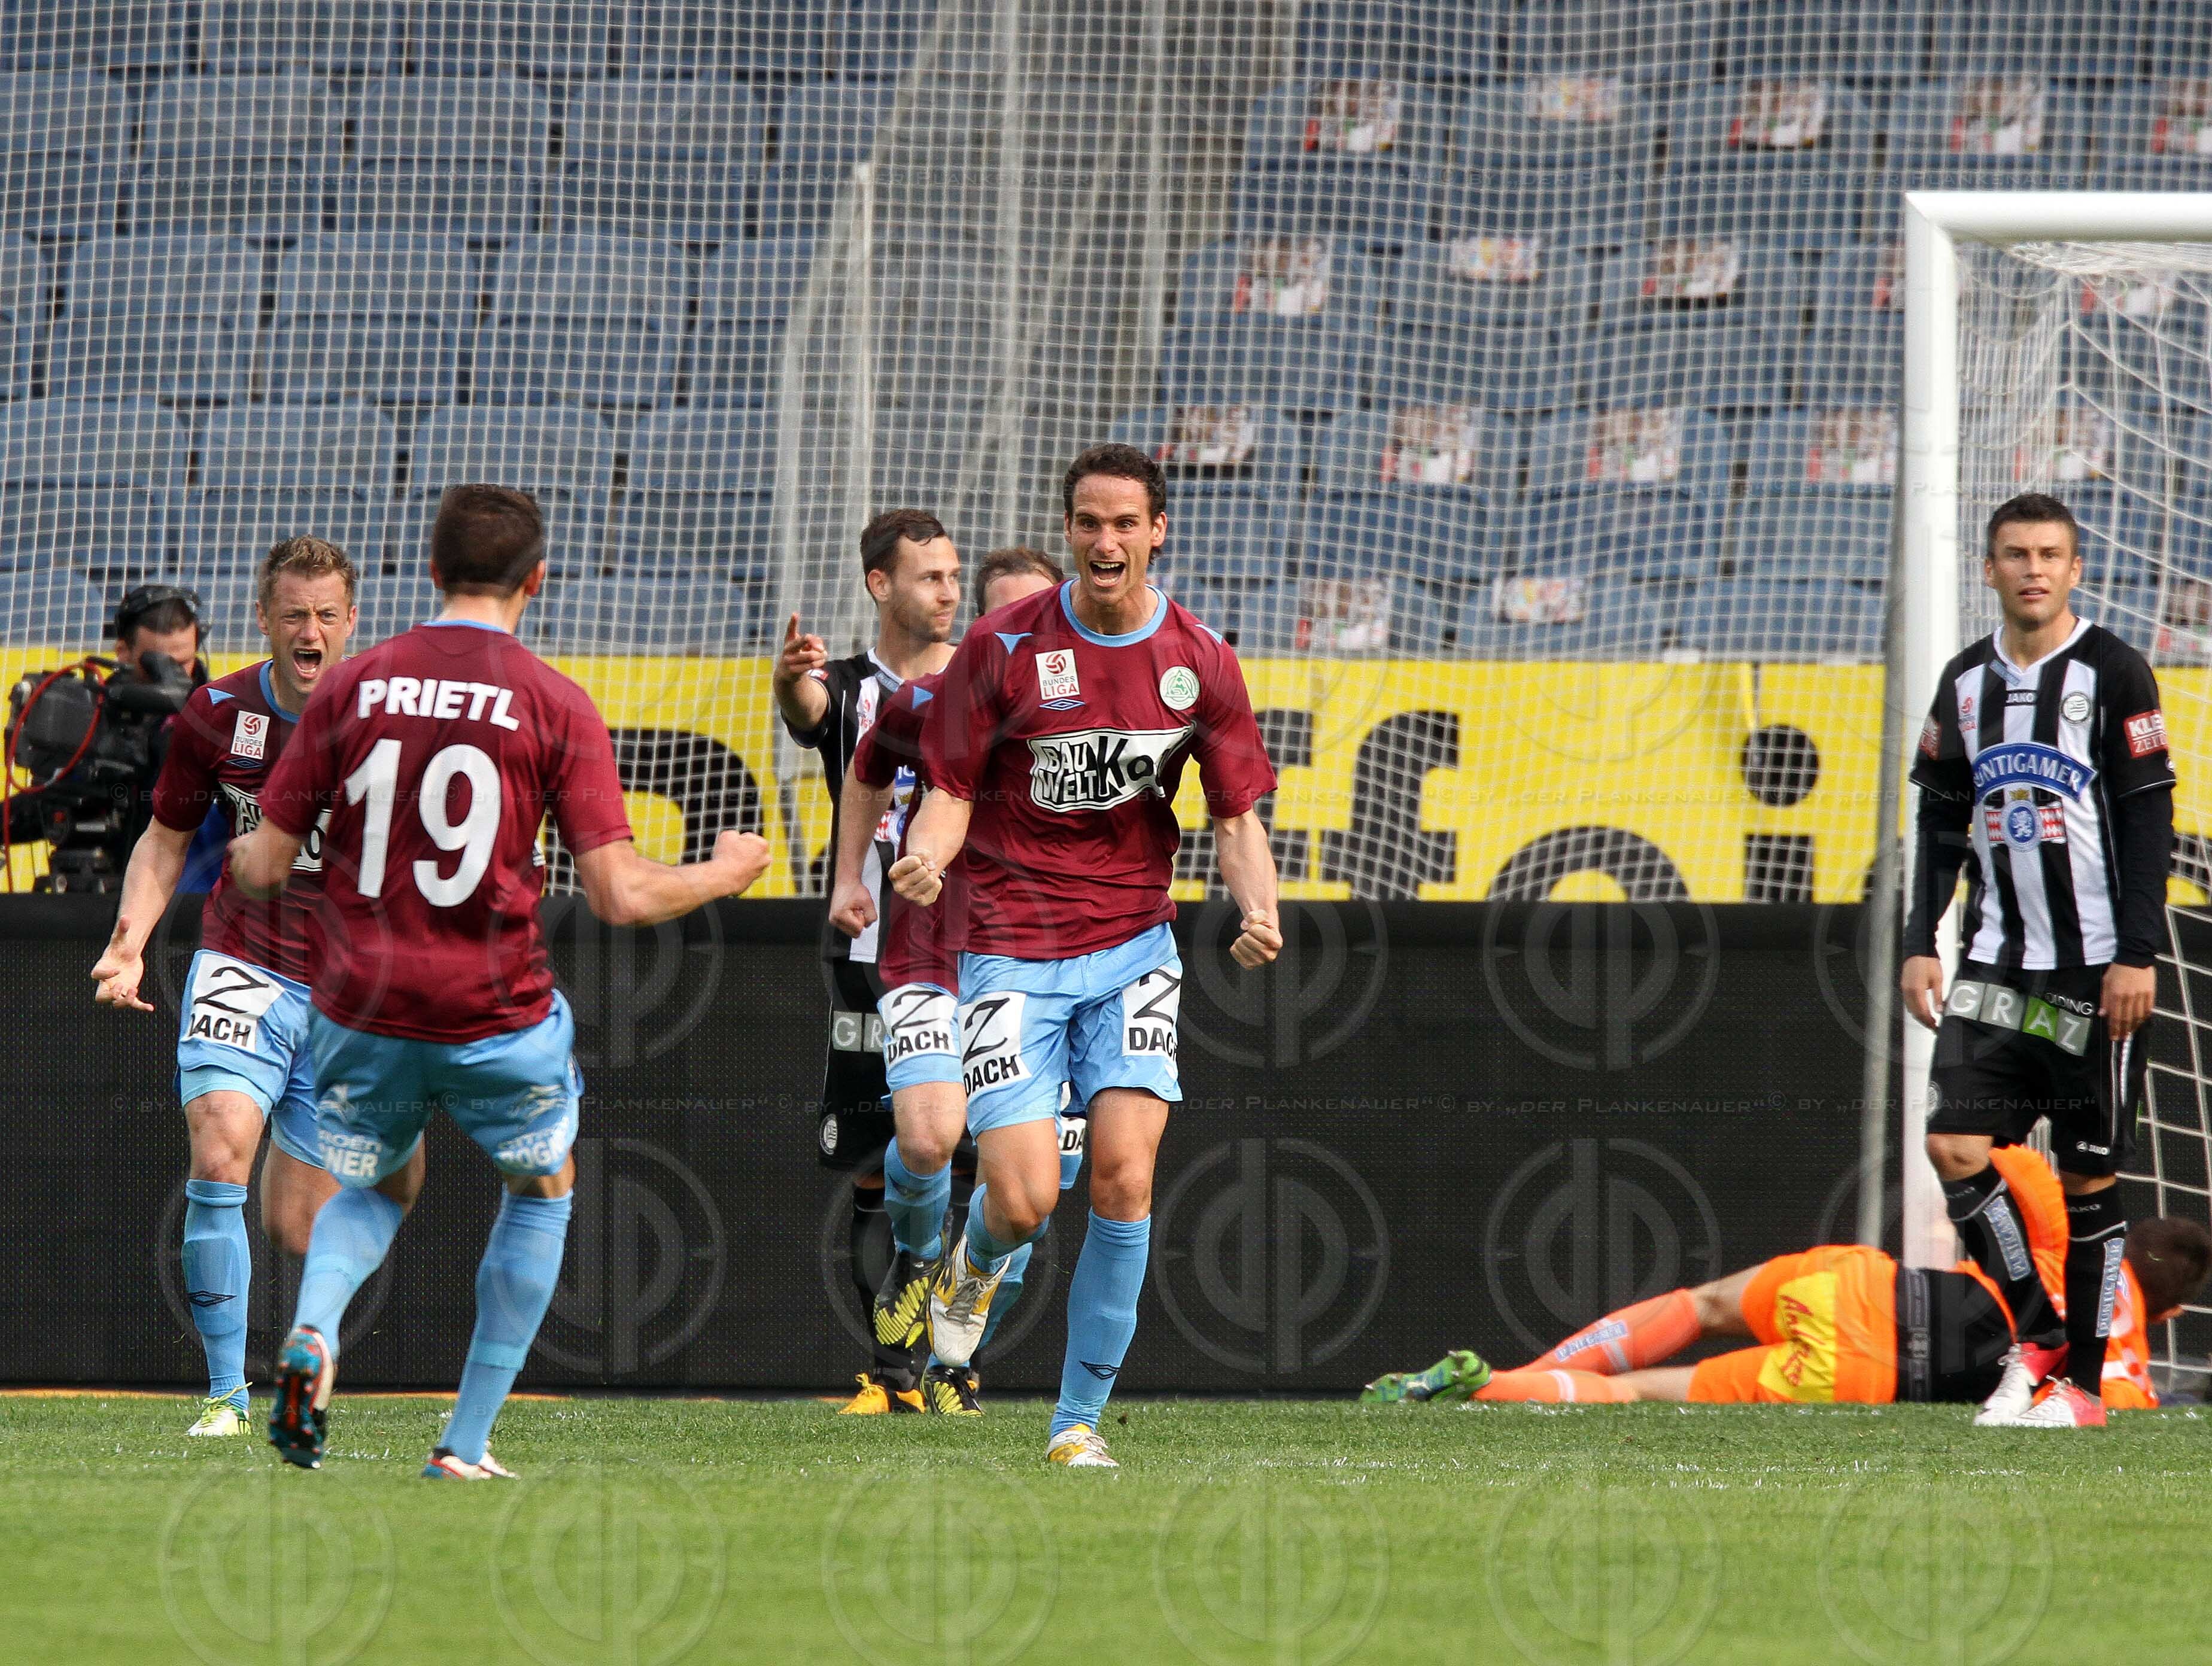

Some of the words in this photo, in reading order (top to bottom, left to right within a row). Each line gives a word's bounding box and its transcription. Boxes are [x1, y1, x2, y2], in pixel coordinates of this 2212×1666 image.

[1042, 676, 1075, 686] BUNDES
[1043, 683, 1078, 697] LIGA
[357, 676, 520, 731] PRIETL
[2006, 692, 2035, 704] JAKO
[233, 743, 262, 758] LIGA
[235, 735, 263, 747] BUNDES
[1040, 741, 1090, 774] BAU
[1038, 768, 1098, 803] WELT
[1975, 751, 2081, 794] UNTIGAMER
[344, 738, 502, 907] 19
[1949, 985, 2081, 1051] GRAZ
[2044, 992, 2094, 1016] OLDING
[888, 1030, 949, 1064] DACH
